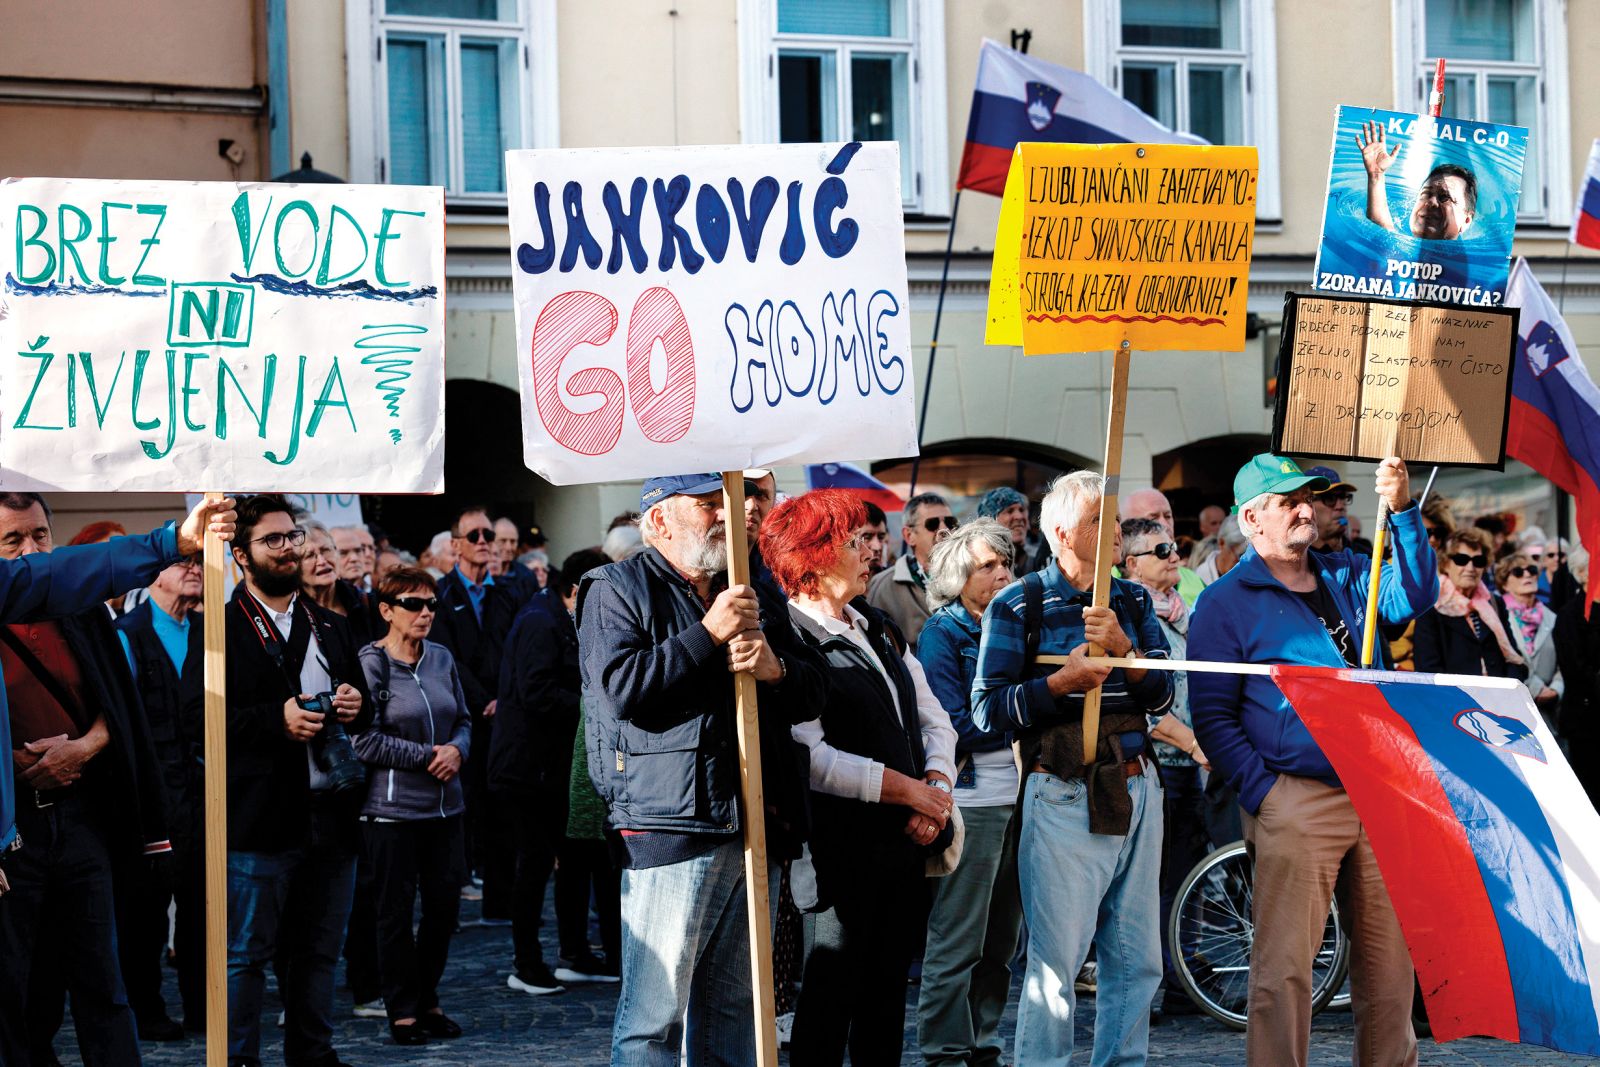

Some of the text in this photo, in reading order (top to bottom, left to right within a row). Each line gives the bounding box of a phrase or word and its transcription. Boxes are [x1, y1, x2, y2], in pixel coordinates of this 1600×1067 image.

[1029, 162, 1149, 205] LJUBLJANČANI
[517, 142, 863, 275] JANKOVIĆ
[16, 191, 426, 287] BREZ VODE
[1026, 216, 1250, 262] IZKOP SVINJSKEGA KANALA
[1385, 259, 1442, 280] POTOP
[1024, 272, 1238, 317] STROGA KAZEN ODGOVORNIH!
[1319, 272, 1502, 306] ZORANA JANKOVIĆA?
[178, 287, 245, 340] NI
[1332, 304, 1373, 317] RODNE
[1385, 310, 1418, 323] ZELO
[1369, 352, 1453, 369] ZASTRUPITI
[1435, 337, 1465, 349] NAM
[531, 286, 905, 456] GO HOME
[1294, 365, 1400, 387] PITNO VODO
[13, 336, 358, 465] ŽIVLJENJA
[1305, 402, 1463, 430] Z DREKOVODOM
[253, 616, 269, 638] Canon
